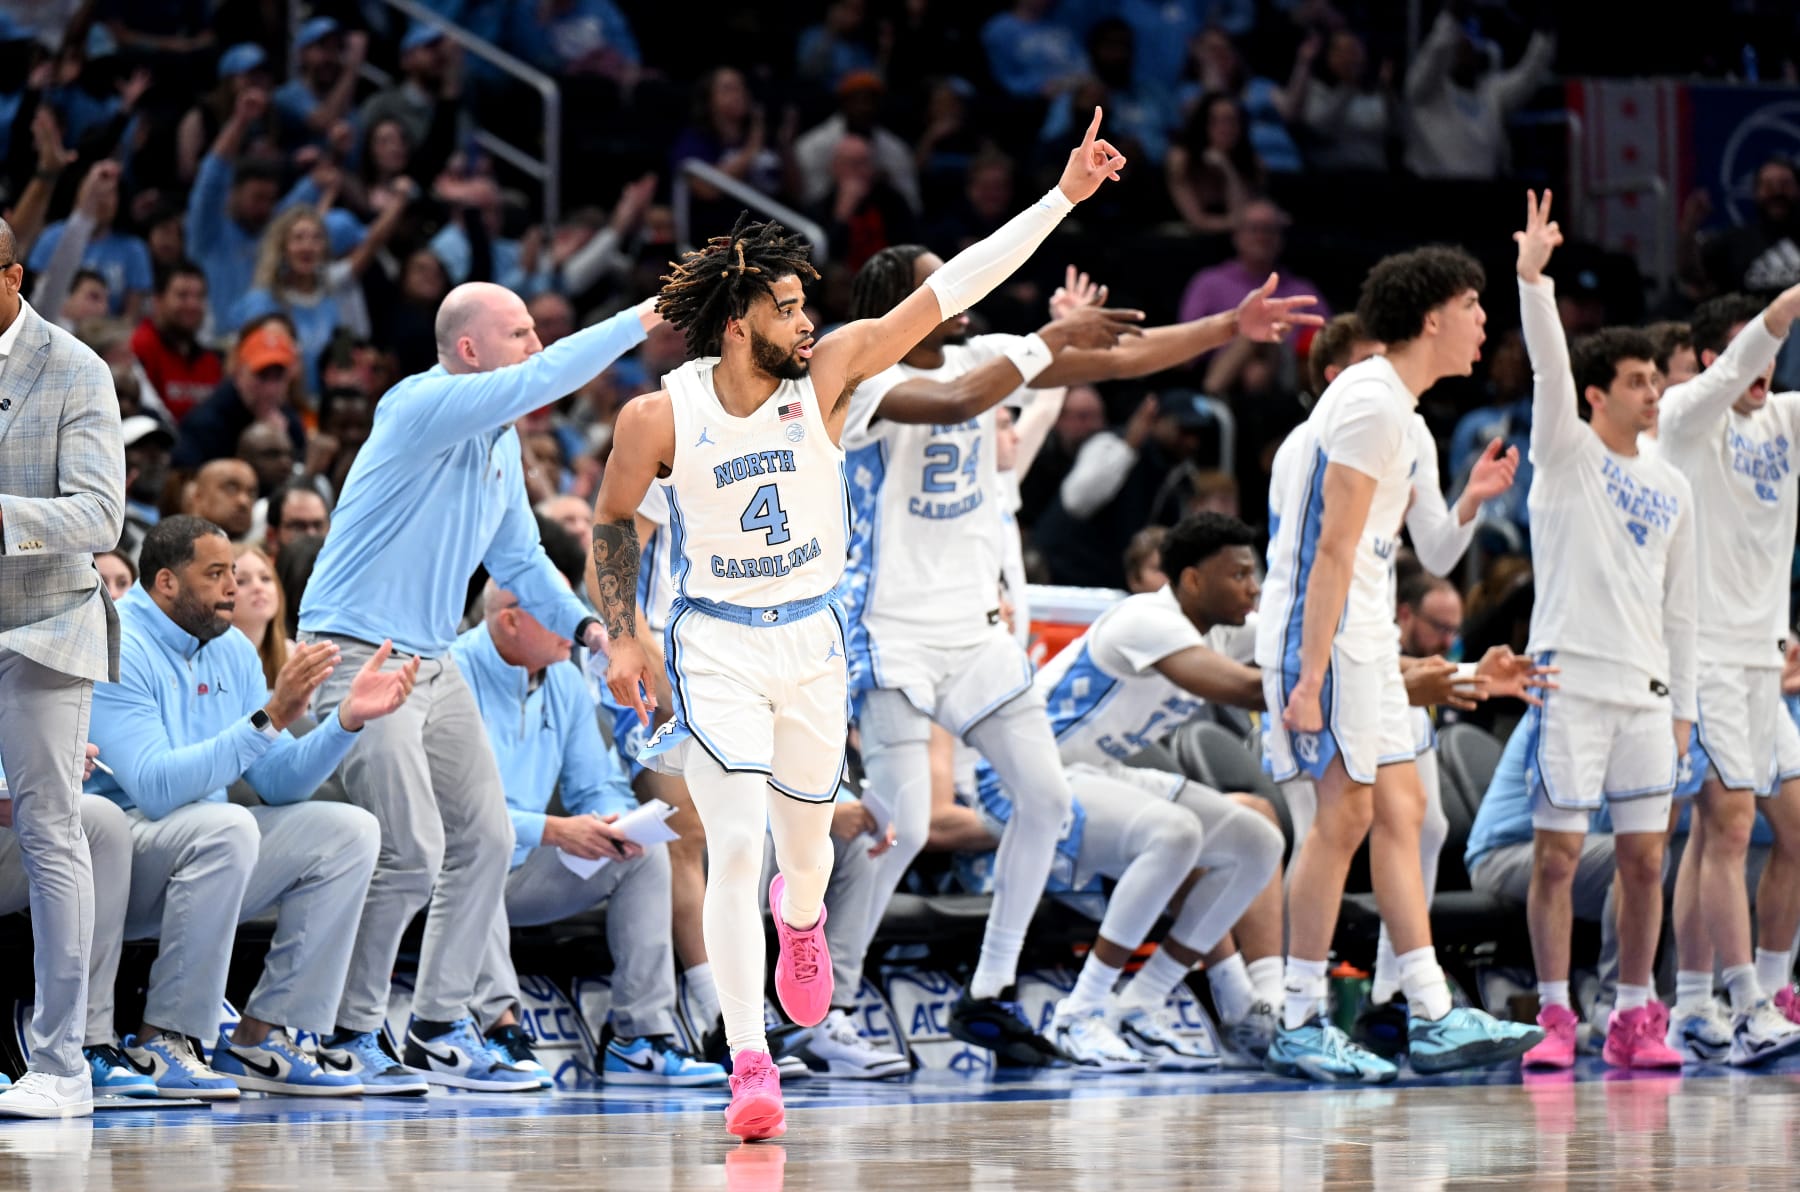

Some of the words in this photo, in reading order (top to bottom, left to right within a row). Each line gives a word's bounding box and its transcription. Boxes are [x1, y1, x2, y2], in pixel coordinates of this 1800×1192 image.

[713, 449, 797, 488] NORTH
[922, 435, 982, 493] 24
[740, 483, 791, 547] 4
[711, 537, 822, 579] CAROLINA
[521, 1008, 580, 1041] ACC
[910, 1002, 957, 1035] AC
